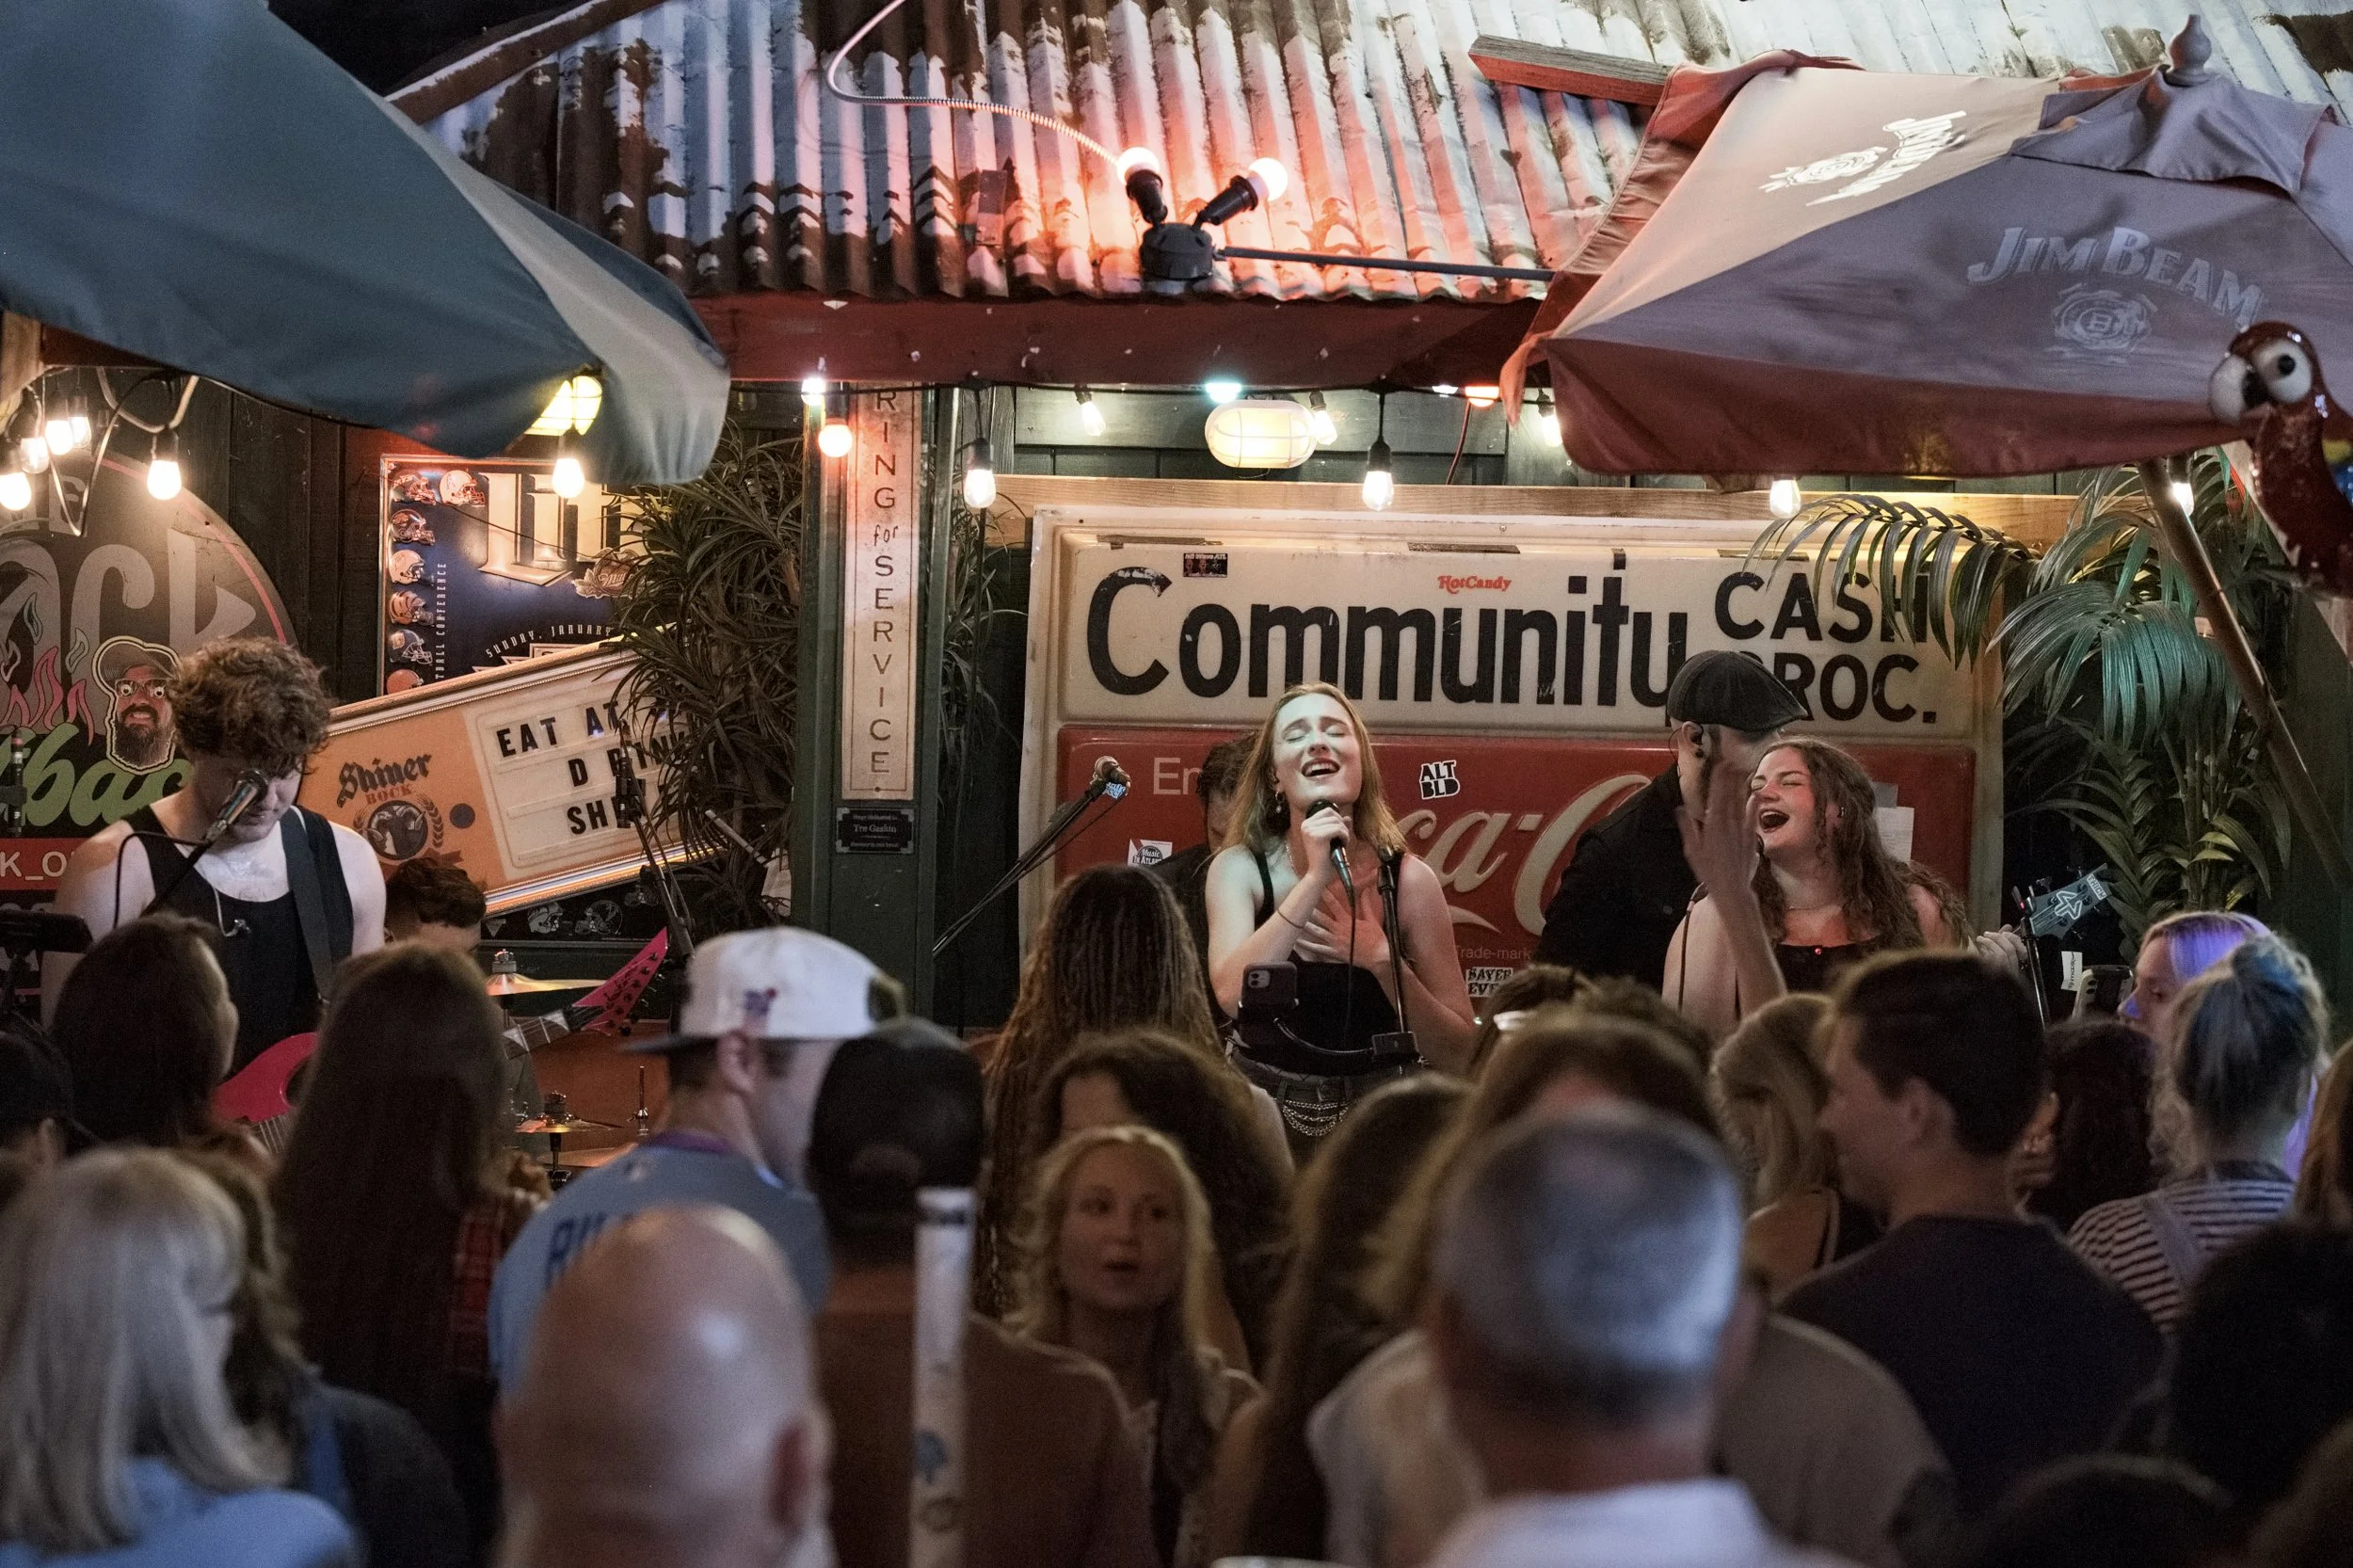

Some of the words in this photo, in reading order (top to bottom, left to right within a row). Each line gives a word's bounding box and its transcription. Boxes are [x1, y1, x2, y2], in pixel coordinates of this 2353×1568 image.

[1967, 227, 2098, 282] JIM
[2102, 227, 2263, 334] BEAM
[873, 523, 899, 547] for
[436, 564, 446, 635] CONFERENCE
[551, 624, 616, 637] JANUARY
[869, 554, 894, 774] SERVICE
[1737, 650, 1937, 724] ROC.
[496, 715, 558, 758] EAT
[337, 754, 432, 808] Shiner
[1420, 761, 1456, 782] ALT
[1421, 778, 1459, 798] BLD
[365, 784, 413, 805] BOCK
[2088, 874, 2106, 900] THICK
